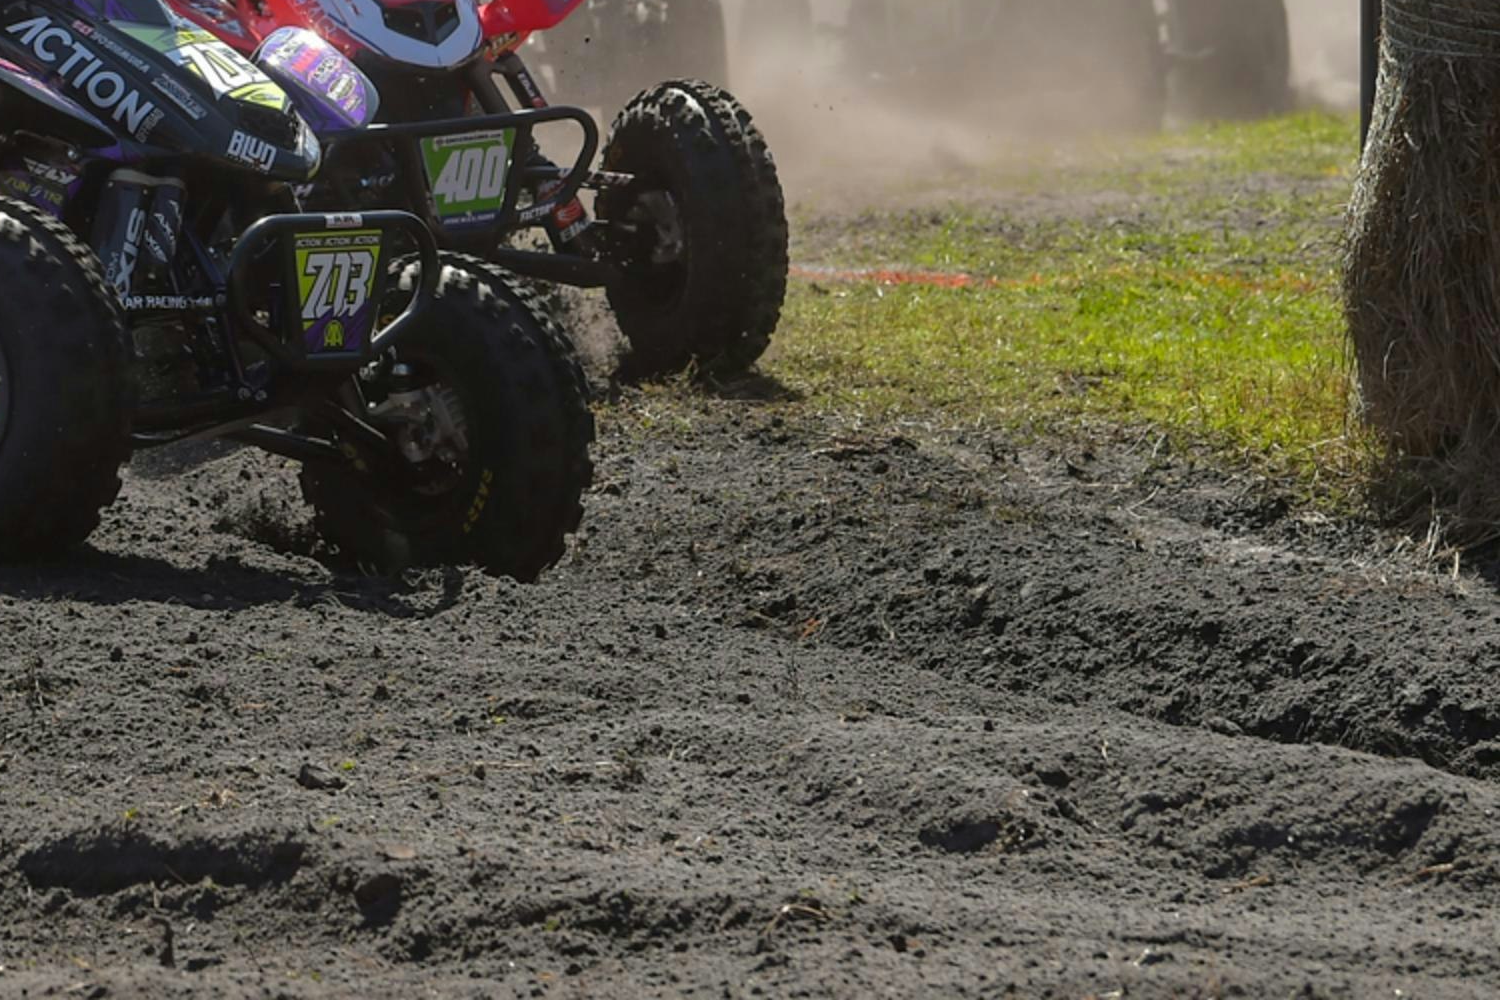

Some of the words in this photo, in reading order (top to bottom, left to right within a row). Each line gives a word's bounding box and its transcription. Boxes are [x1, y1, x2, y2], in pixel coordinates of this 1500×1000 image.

[6, 16, 156, 135] ACTION
[432, 145, 509, 205] 400
[301, 250, 374, 320] 703
